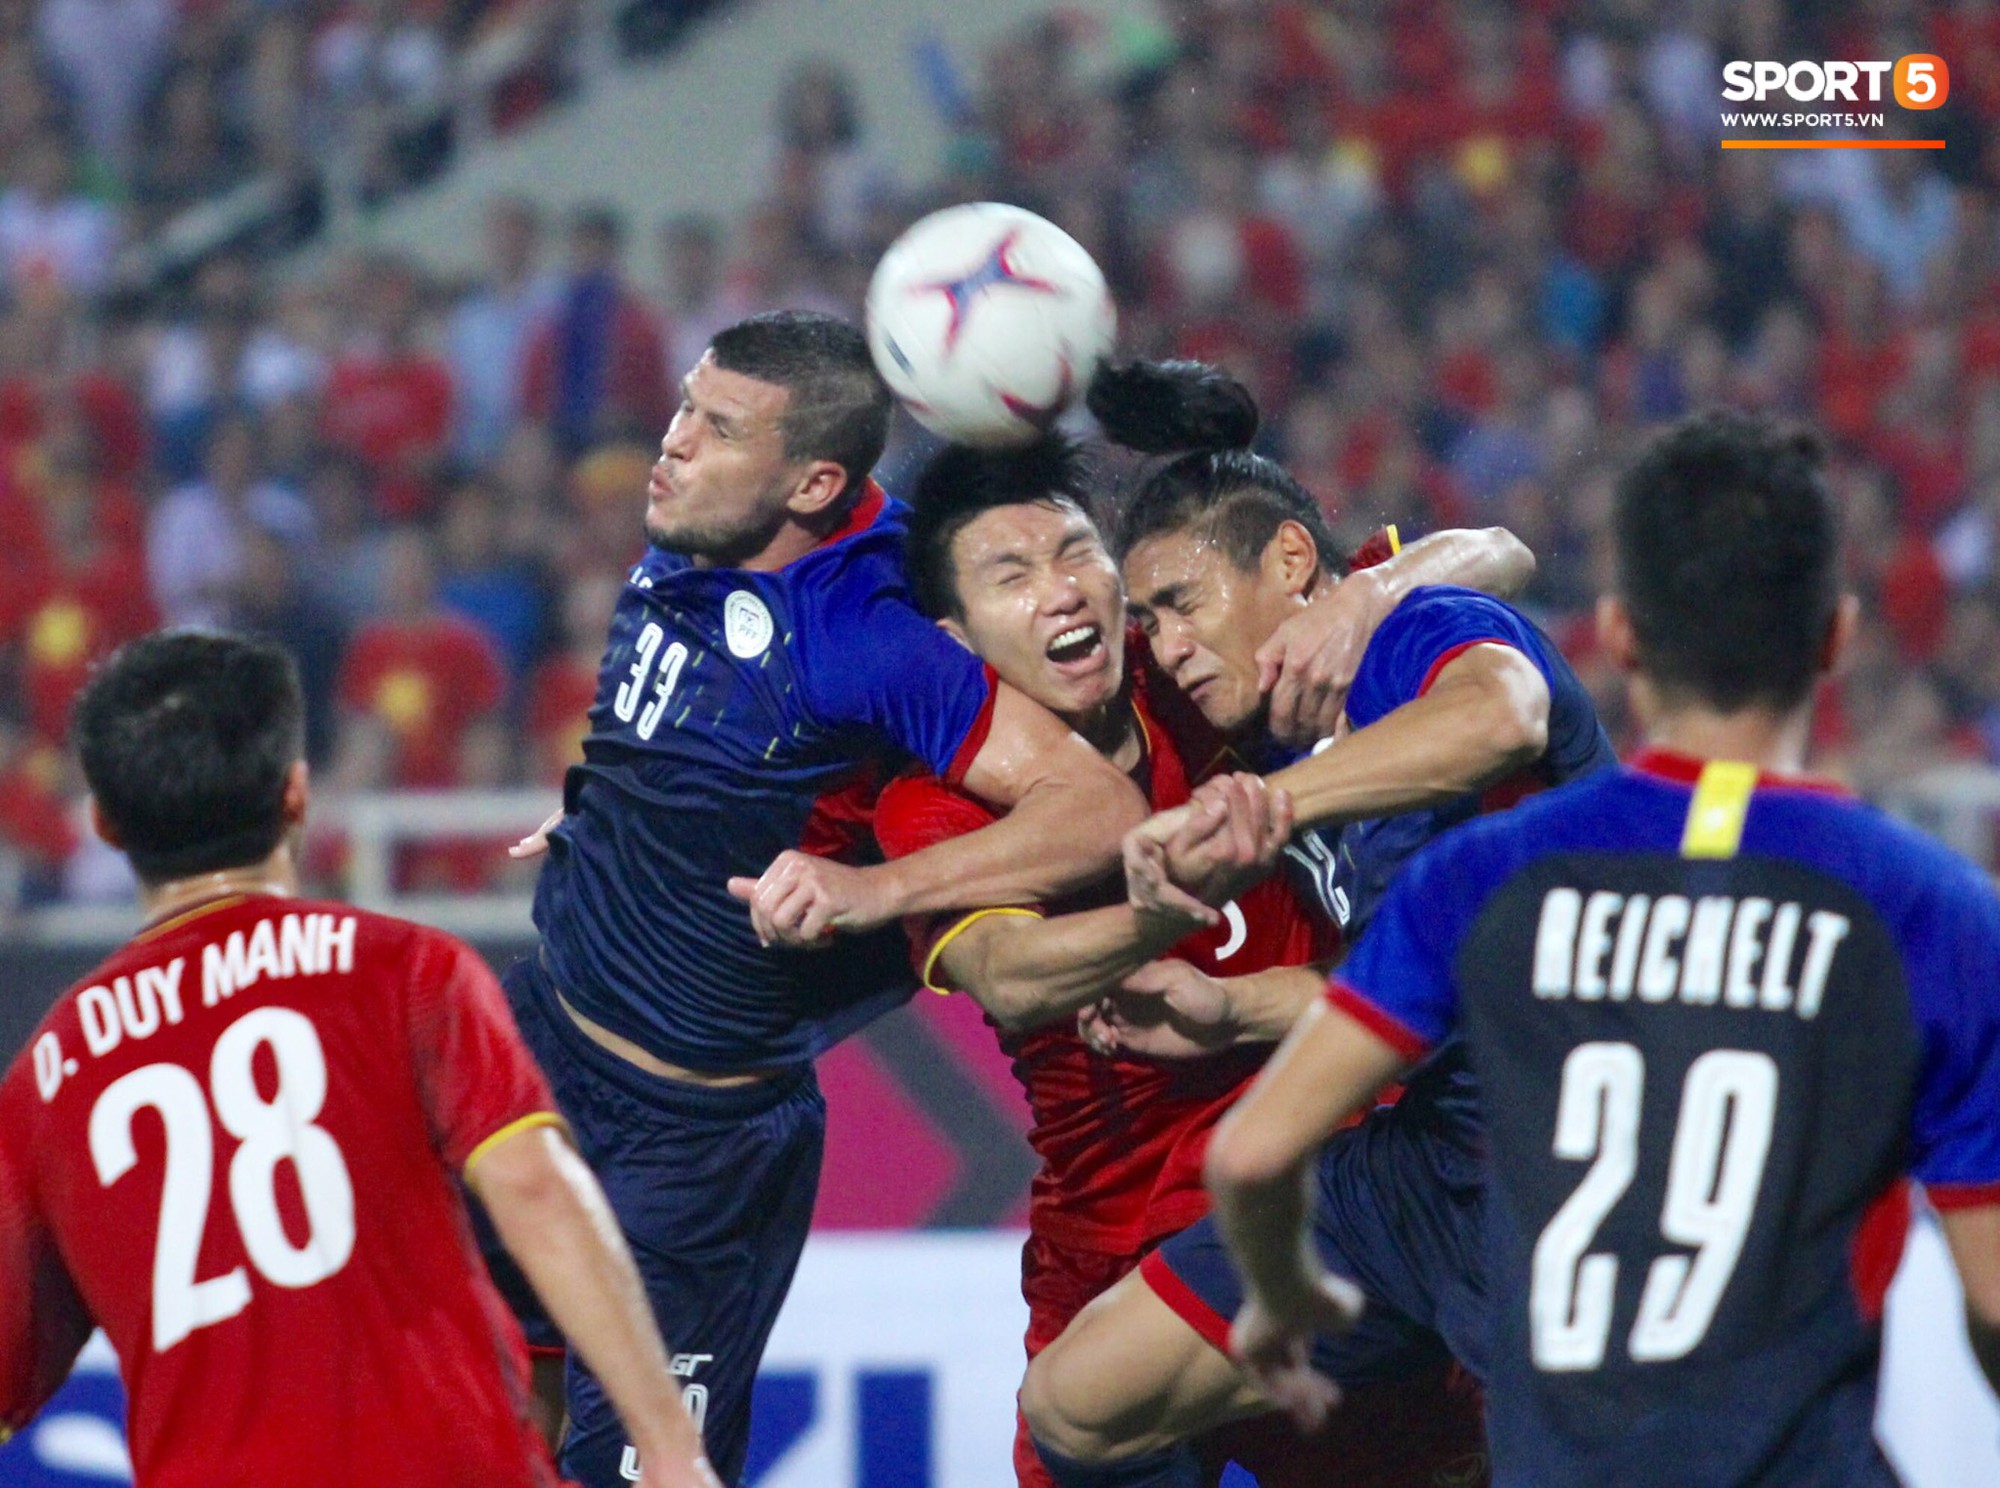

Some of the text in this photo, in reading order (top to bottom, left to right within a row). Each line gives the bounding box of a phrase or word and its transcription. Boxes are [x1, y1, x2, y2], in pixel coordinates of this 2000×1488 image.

[613, 622, 689, 740] 33
[32, 913, 357, 1102] D. DUY MANH
[1532, 887, 1850, 1020] REICHELT
[87, 1006, 356, 1354] 28
[1529, 1041, 1779, 1372] 29
